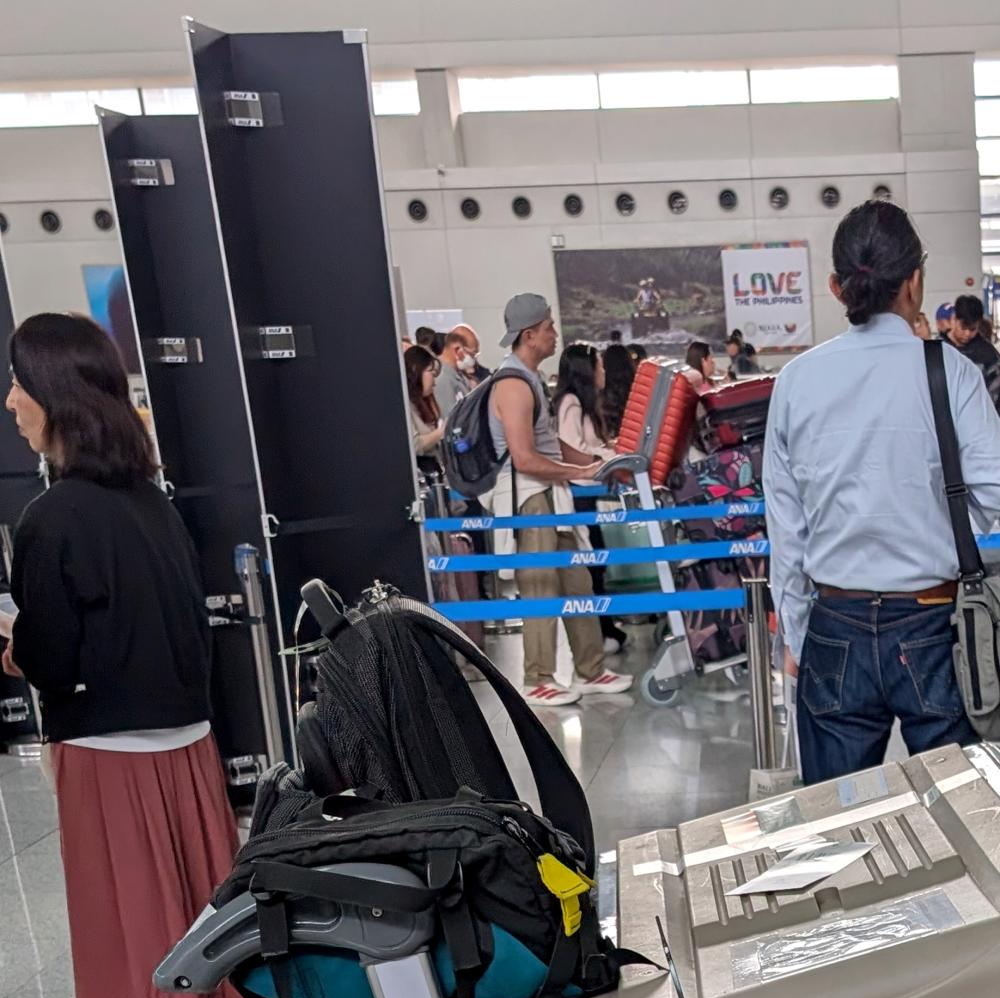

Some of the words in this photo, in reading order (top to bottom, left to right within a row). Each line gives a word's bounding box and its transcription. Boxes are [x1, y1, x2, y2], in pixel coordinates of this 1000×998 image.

[732, 270, 803, 297] LOVE
[734, 298, 750, 306] THE
[752, 295, 804, 306] PHILIPPINES
[727, 504, 750, 514] ANA
[595, 512, 618, 523] ANA
[461, 518, 483, 529] ANA
[728, 542, 755, 554] ANA
[570, 552, 597, 564] ANA
[562, 599, 594, 614] ANA
